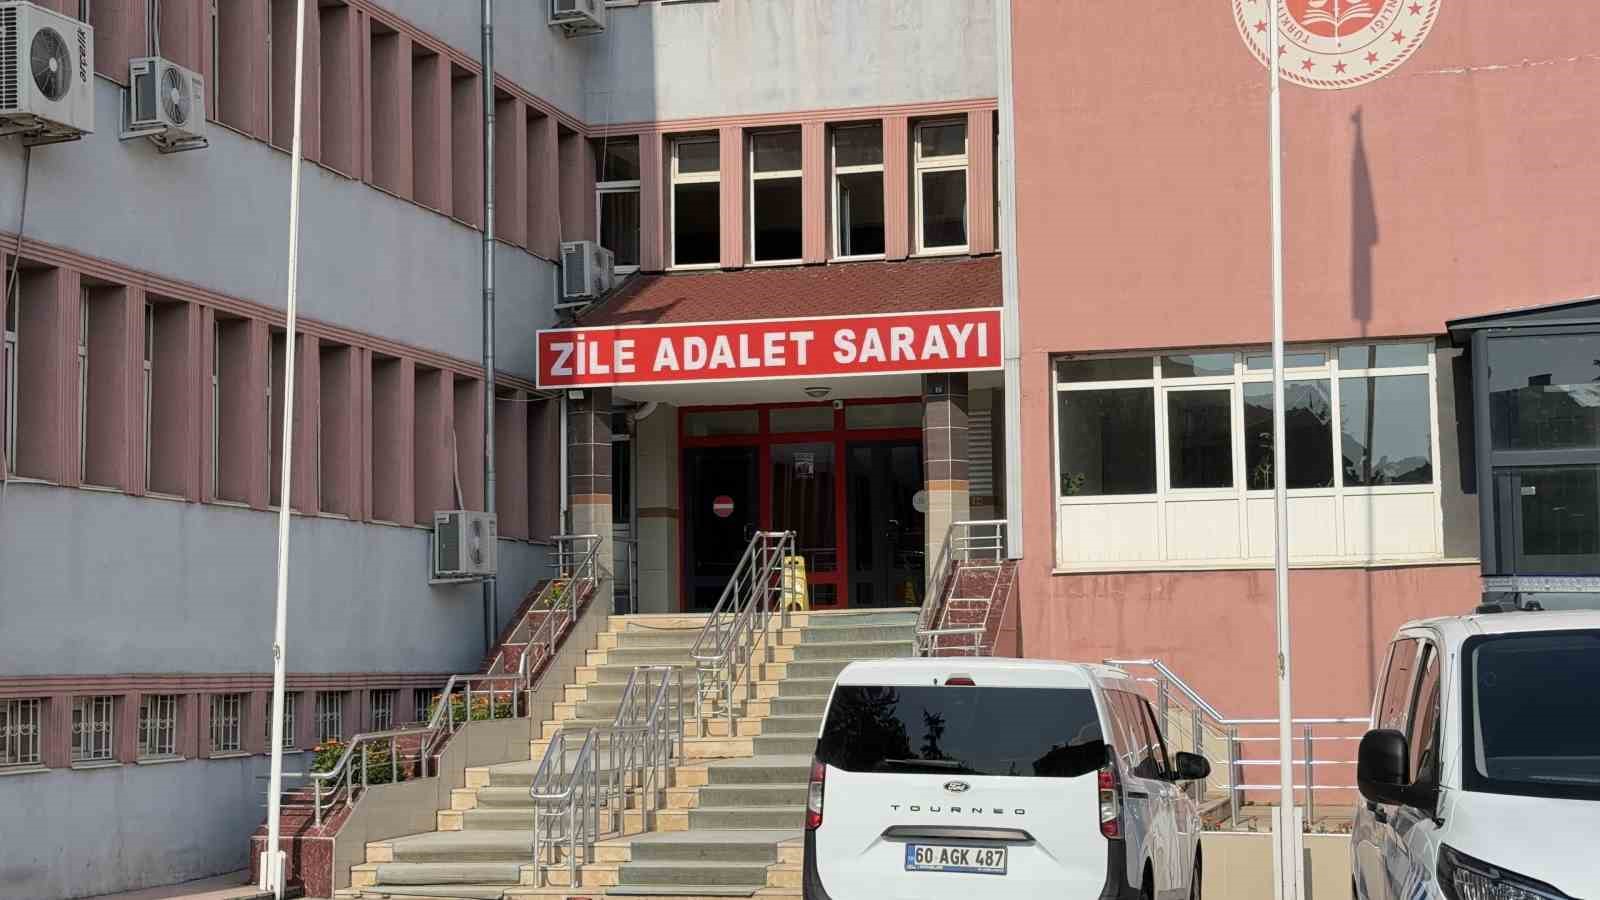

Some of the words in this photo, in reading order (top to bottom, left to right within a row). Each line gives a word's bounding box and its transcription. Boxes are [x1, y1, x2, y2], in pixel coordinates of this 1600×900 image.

[550, 334, 635, 376] ZİLE
[653, 331, 814, 371] ADALET
[833, 323, 987, 363] SARAYI
[891, 804, 1025, 815] TOURNEO
[916, 847, 933, 863] 60
[940, 848, 969, 865] AGK
[976, 850, 1003, 866] 487
